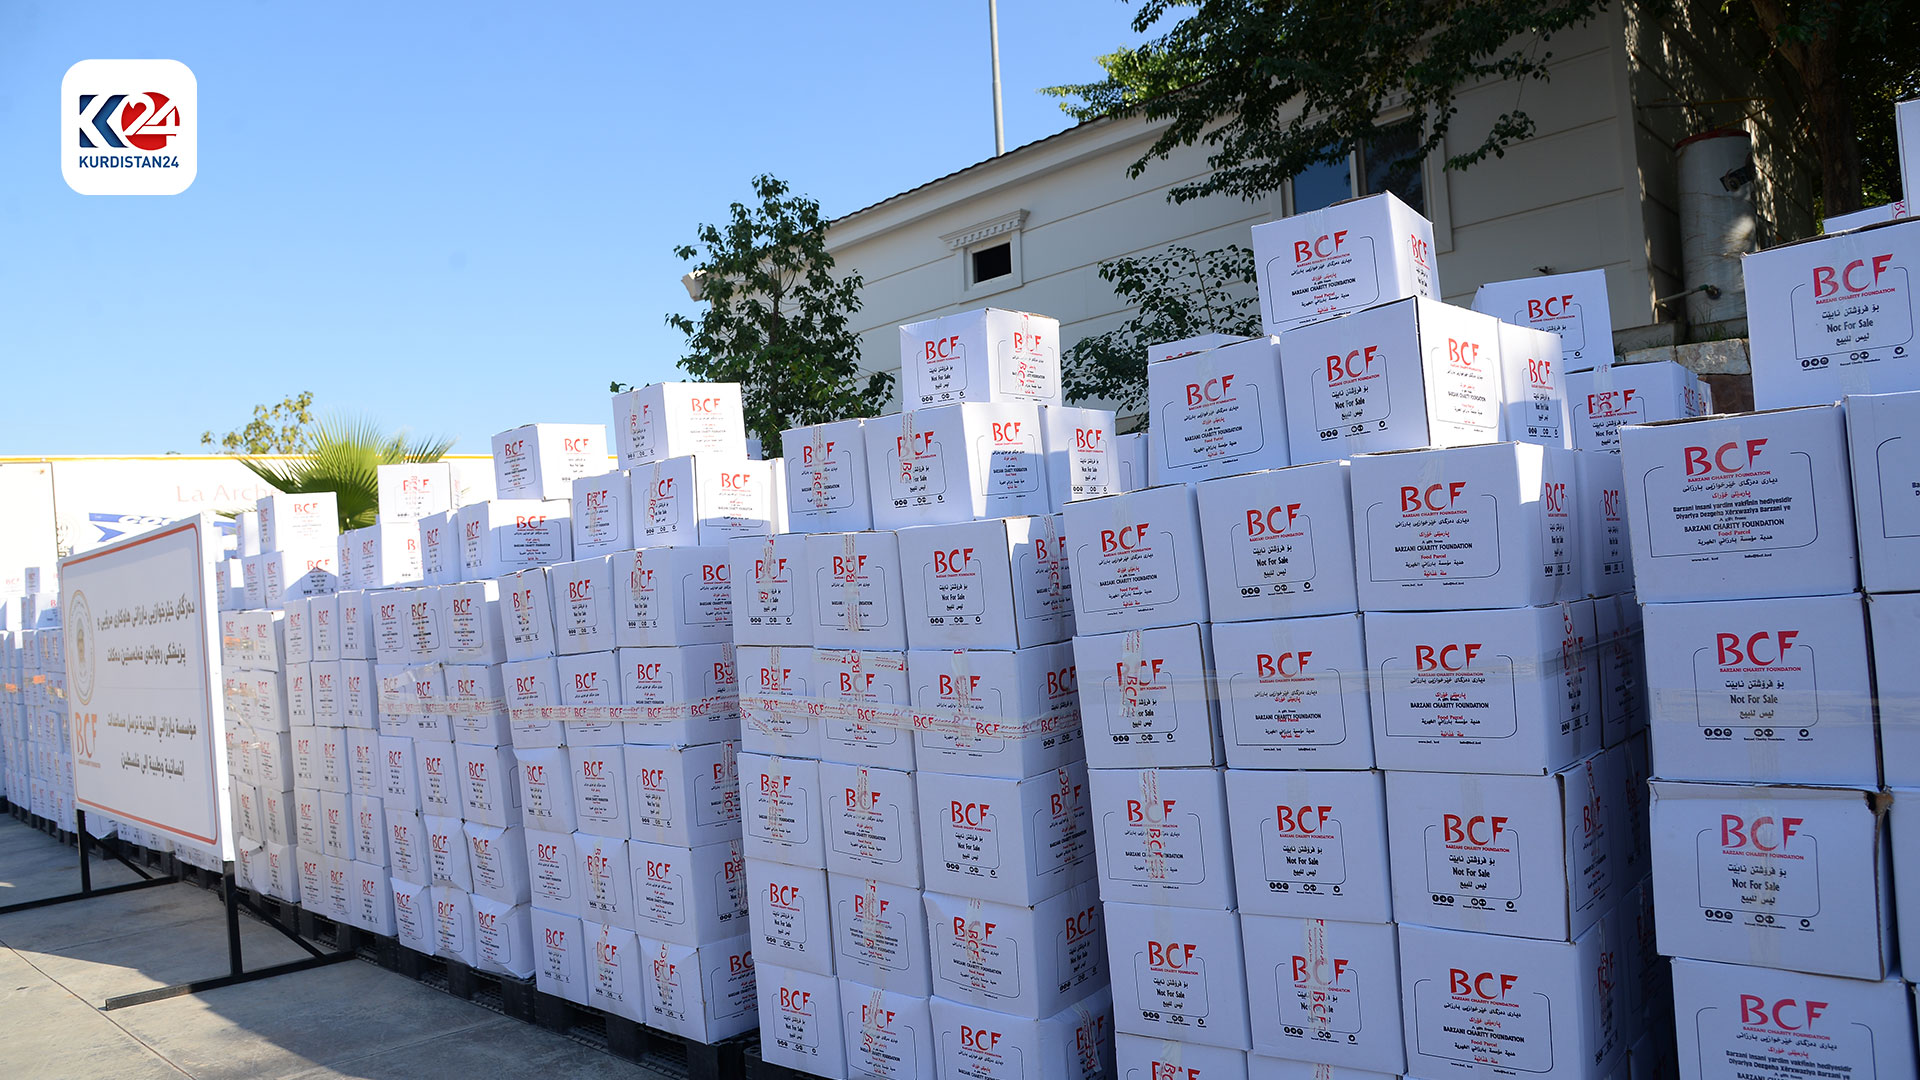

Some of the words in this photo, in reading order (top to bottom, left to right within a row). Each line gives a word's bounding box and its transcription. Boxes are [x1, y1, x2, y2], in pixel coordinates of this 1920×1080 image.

[1294, 230, 1348, 263] BCF
[1411, 234, 1428, 263] BCF
[1813, 253, 1894, 298] BCF
[1528, 295, 1574, 319] BCF
[1826, 324, 1841, 333] Not
[1844, 321, 1856, 331] For
[1858, 318, 1874, 329] Sale
[925, 335, 960, 360] BCF
[1448, 338, 1479, 365] BCF
[1326, 345, 1378, 383] BCF
[1528, 359, 1550, 385] BCF
[1186, 374, 1235, 406] BCF
[691, 398, 721, 412] BCF
[991, 422, 1021, 443] BCF
[1076, 428, 1102, 449] BCF
[505, 440, 524, 457] BCF
[564, 438, 589, 452] BCF
[1684, 438, 1769, 477] BCF
[720, 473, 751, 489] BCF
[177, 485, 204, 502] La
[1401, 481, 1467, 512] BCF
[1545, 482, 1566, 512] BCF
[294, 503, 318, 513] BCF
[1246, 503, 1301, 536] BCF
[516, 516, 547, 529] BCF
[1684, 525, 1711, 533] BARZANI
[1713, 522, 1740, 531] CHARITY
[1742, 518, 1785, 528] FOUNDATION
[1100, 522, 1149, 553] BCF
[1416, 544, 1438, 552] CHARITY
[1439, 542, 1473, 550] FOUNDATION
[934, 548, 974, 574] BCF
[1256, 557, 1267, 567] Not
[1267, 557, 1277, 566] For
[1278, 555, 1289, 565] Sale
[569, 579, 590, 599] BCF
[411, 602, 427, 617] BCF
[453, 598, 472, 613] BCF
[1415, 643, 1482, 671] BCF
[1716, 631, 1800, 666] BCF
[637, 663, 661, 681] BCF
[1256, 651, 1312, 679] BCF
[457, 679, 475, 694] BCF
[516, 676, 535, 693] BCF
[575, 672, 597, 690] BCF
[1048, 665, 1076, 692] BCF
[1730, 694, 1745, 704] Not
[1747, 694, 1760, 703] For
[1763, 694, 1778, 704] Sale
[75, 711, 98, 759] BCF
[468, 762, 486, 779] BCF
[527, 765, 543, 782] BCF
[584, 761, 603, 777] BCF
[641, 768, 664, 788] BCF
[951, 800, 990, 826] BCF
[1127, 800, 1176, 823] BCF
[1276, 805, 1333, 833] BCF
[1443, 814, 1509, 846] BCF
[1721, 814, 1804, 852] BCF
[432, 834, 448, 852] BCF
[538, 844, 557, 859] BCF
[647, 860, 671, 879] BCF
[1451, 866, 1465, 876] Not
[1466, 868, 1477, 877] For
[1477, 869, 1490, 879] Sale
[769, 882, 799, 905] BCF
[1732, 878, 1747, 889] Not
[1750, 880, 1762, 890] For
[1765, 881, 1780, 892] Sale
[478, 911, 496, 928] BCF
[1066, 906, 1095, 941] BCF
[545, 928, 565, 946] BCF
[1148, 941, 1197, 970] BCF
[1292, 955, 1349, 986] BCF
[1450, 968, 1518, 1000] BCF
[779, 986, 811, 1011] BCF
[1740, 994, 1829, 1030] BCF
[961, 1025, 1002, 1051] BCF
